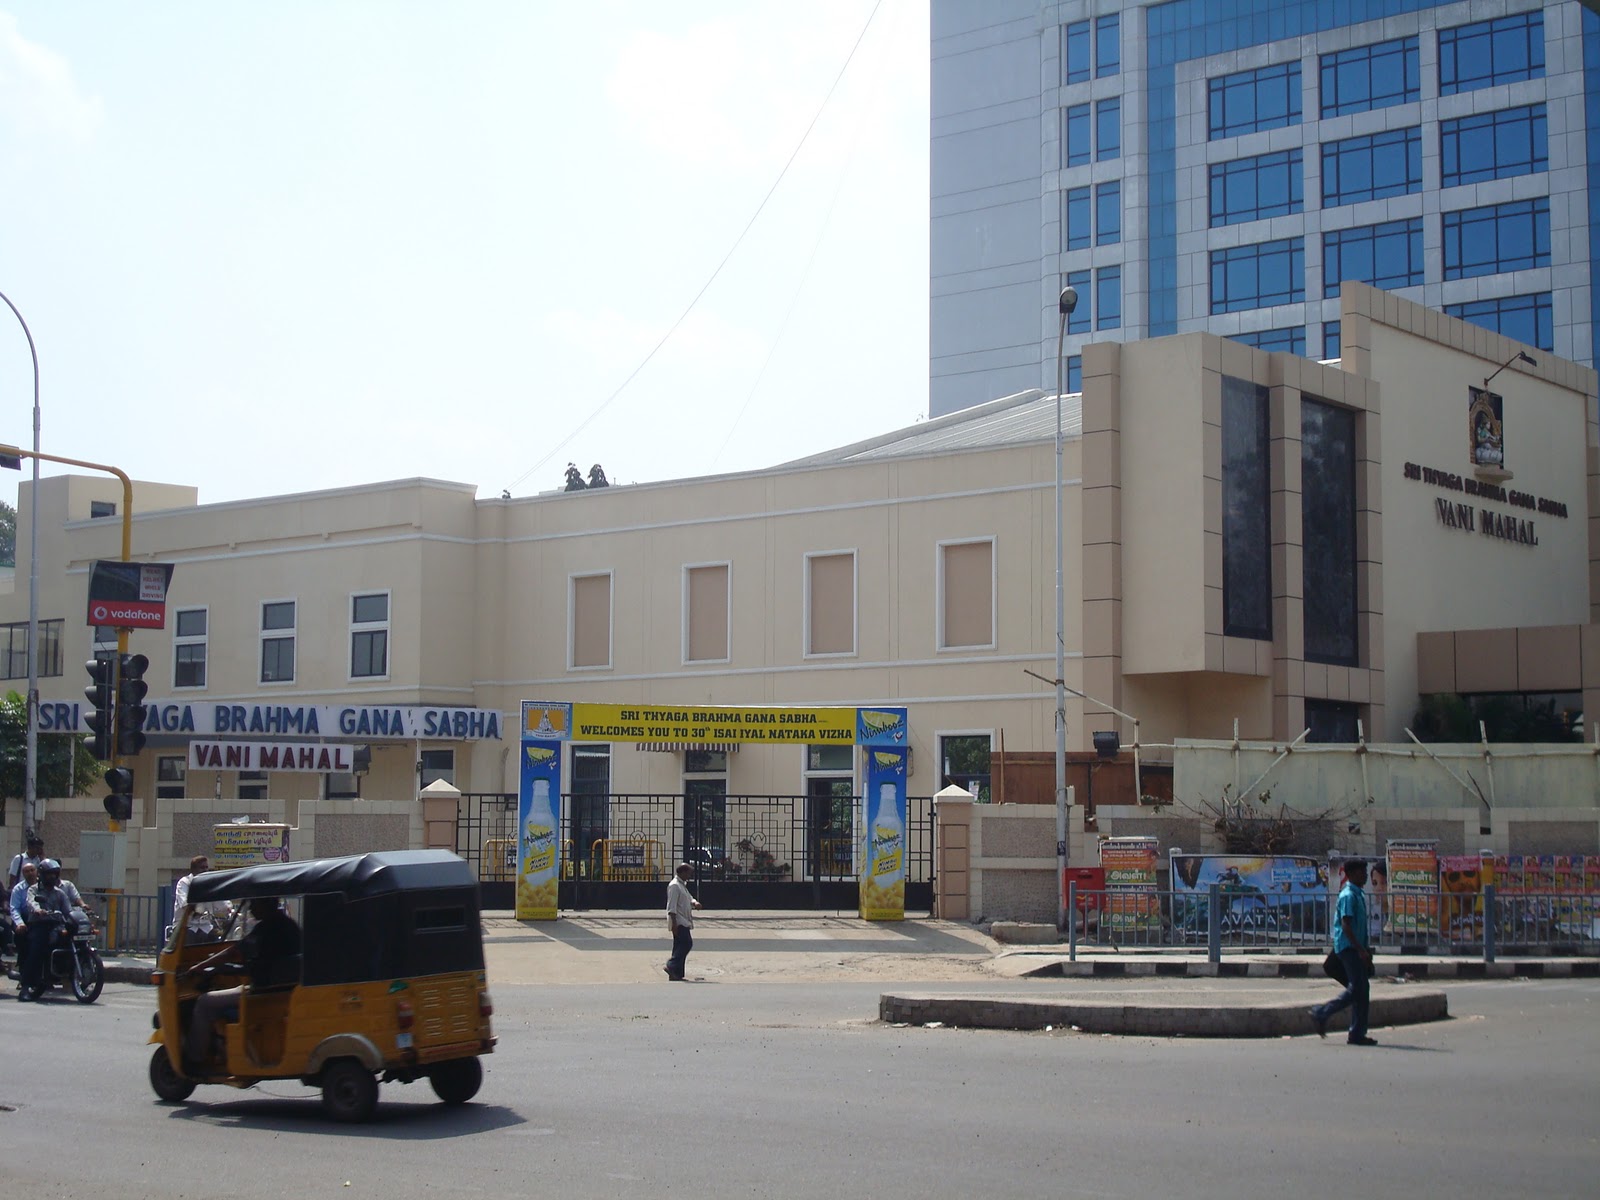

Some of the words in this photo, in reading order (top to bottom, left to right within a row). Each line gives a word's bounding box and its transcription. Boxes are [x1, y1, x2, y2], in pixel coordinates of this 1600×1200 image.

[1436, 497, 1475, 532] VANI
[1482, 509, 1538, 546] MAHAL
[111, 609, 161, 621] vodafone
[39, 703, 79, 731] SRI
[215, 705, 319, 734] BRAHMA
[339, 708, 404, 736] GANA
[423, 710, 502, 740] SABHA
[620, 710, 641, 721] SRI
[643, 711, 690, 722] THYAGA
[692, 712, 742, 723] BRAHMA
[745, 712, 777, 724] GANA
[779, 713, 817, 724] SABHA
[580, 724, 645, 737] WELCOMES
[647, 725, 671, 737] YOU
[673, 726, 689, 738] TO
[713, 727, 737, 739] ISAI
[739, 727, 766, 739] IYAL
[768, 728, 816, 740] NATAKA
[819, 728, 852, 740] VIZHA
[195, 744, 250, 768] VANI
[259, 746, 349, 770] MAHAL
